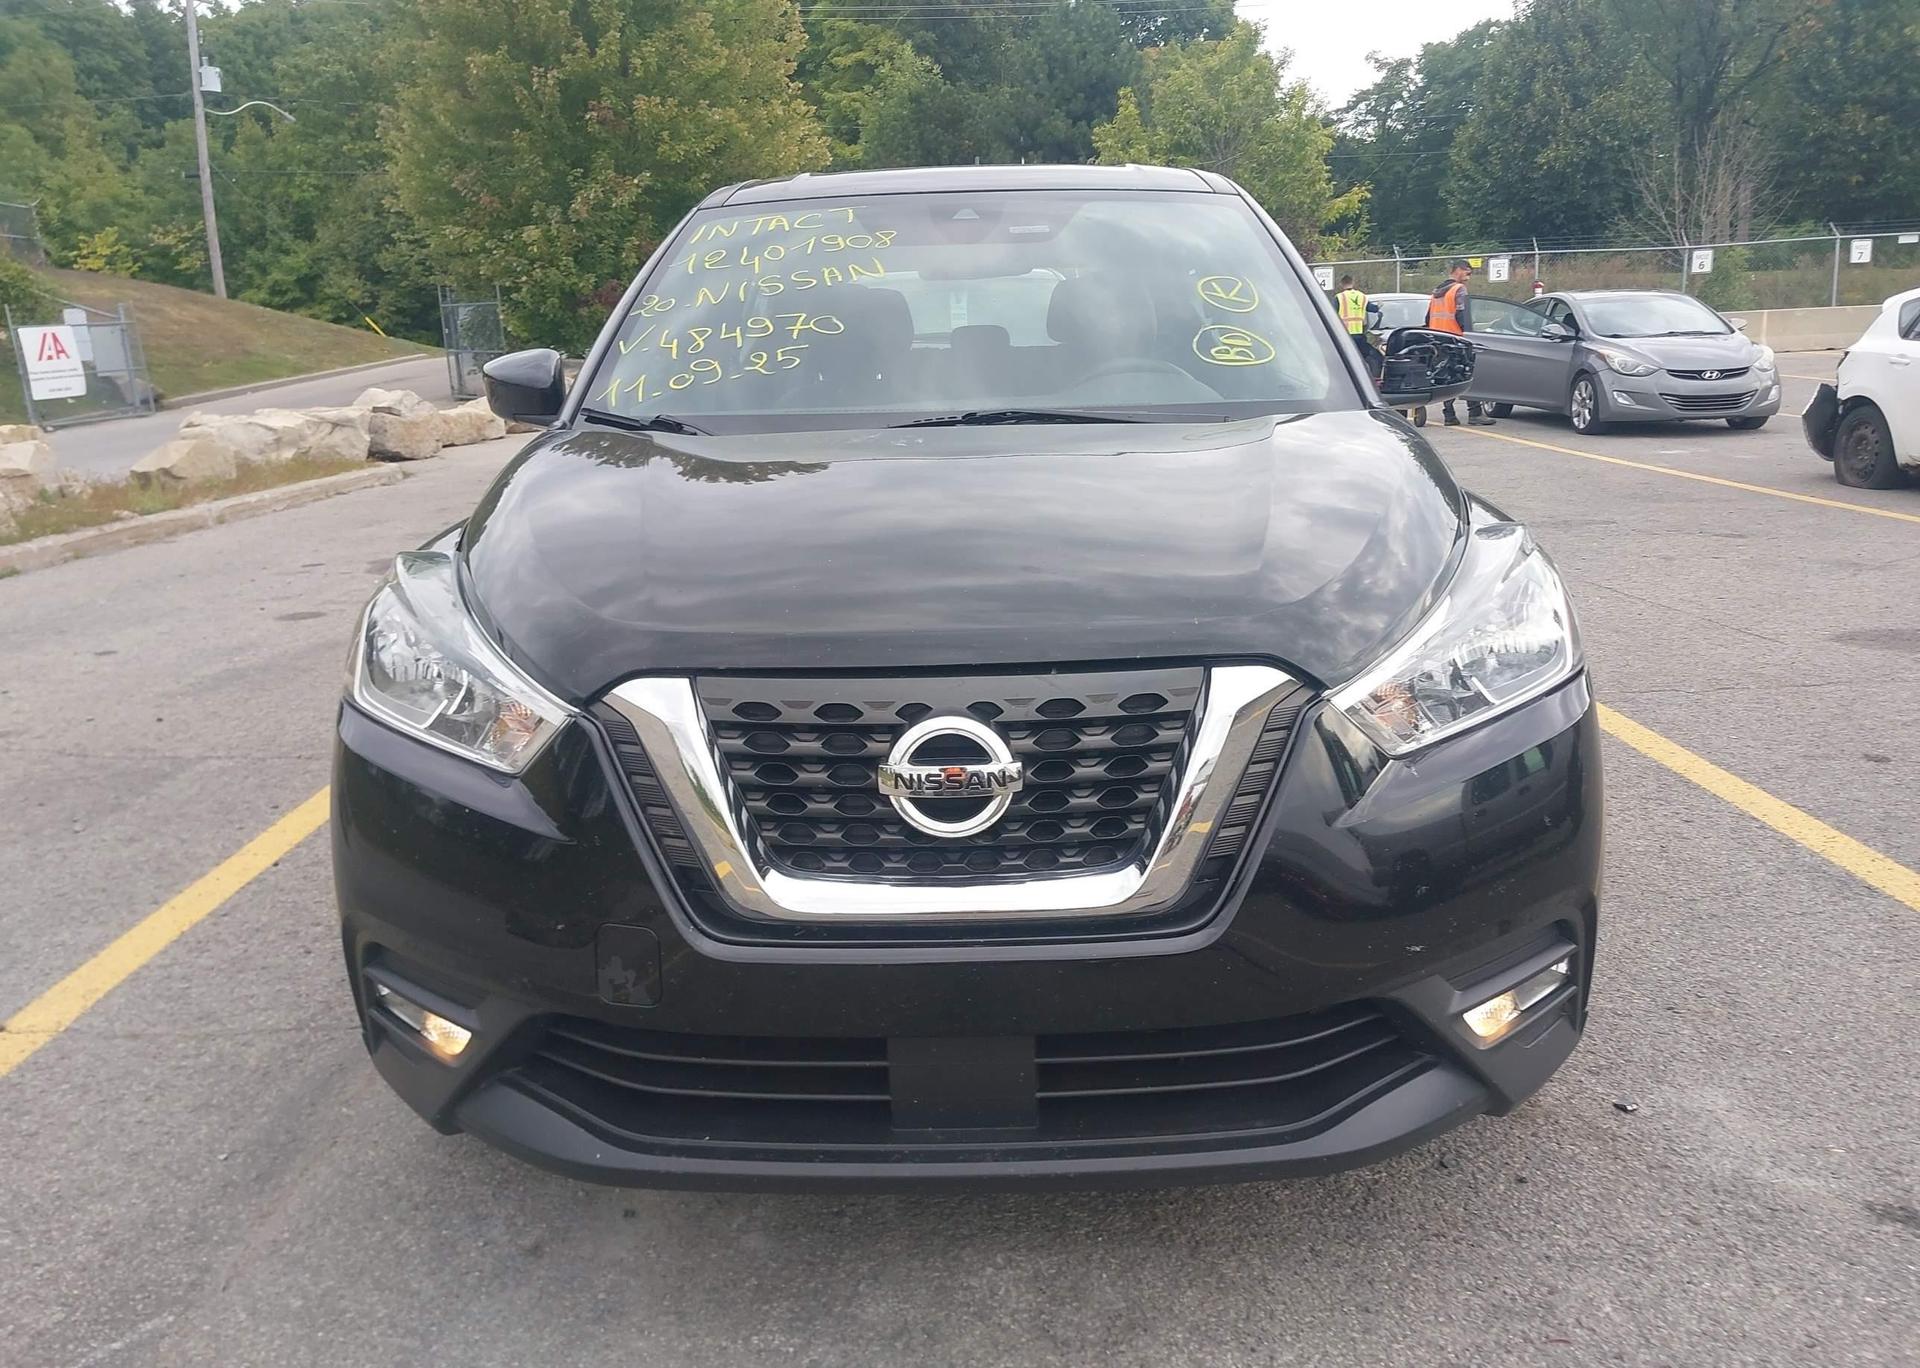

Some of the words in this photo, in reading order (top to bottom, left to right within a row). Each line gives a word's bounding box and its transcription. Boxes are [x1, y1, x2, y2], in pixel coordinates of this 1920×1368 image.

[690, 206, 867, 244] INTACT
[1857, 251, 1864, 261] 7
[1698, 261, 1705, 270] 6
[1496, 269, 1502, 279] 5
[894, 768, 1008, 791] NISSAN
